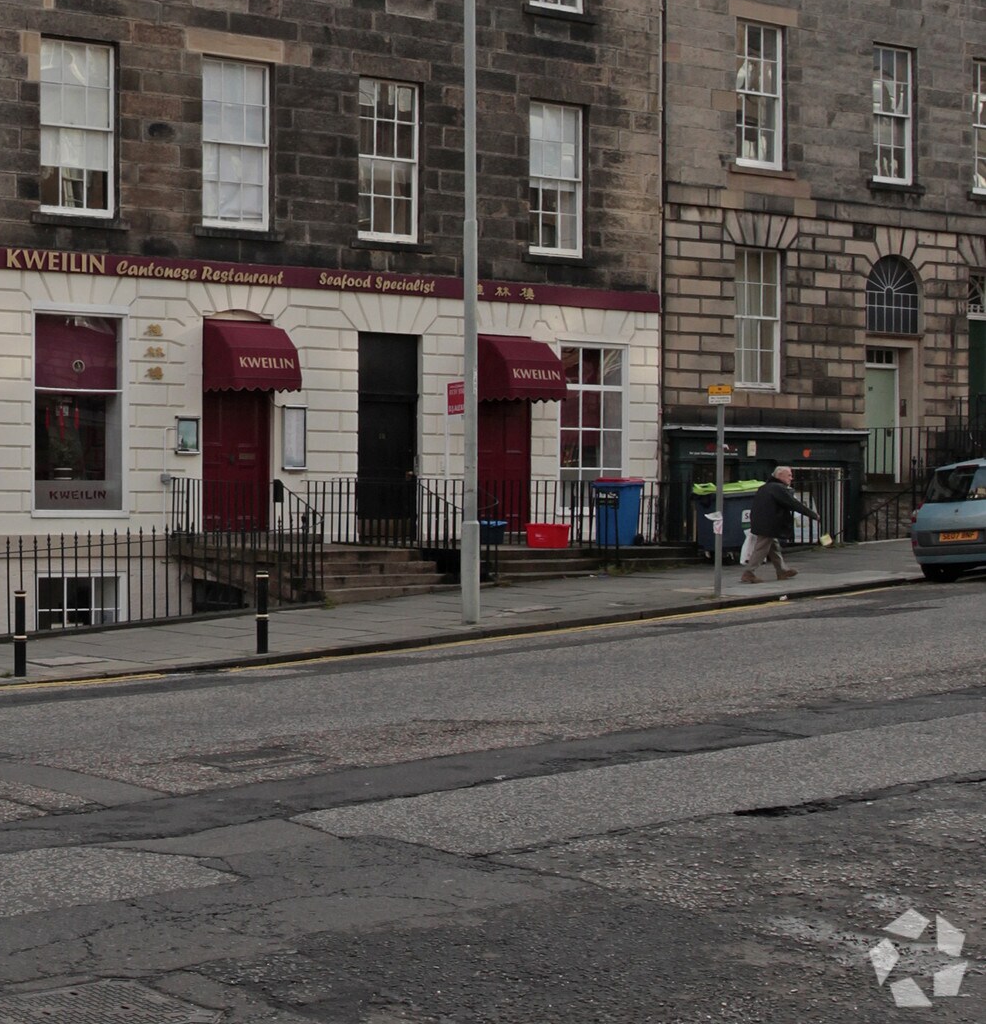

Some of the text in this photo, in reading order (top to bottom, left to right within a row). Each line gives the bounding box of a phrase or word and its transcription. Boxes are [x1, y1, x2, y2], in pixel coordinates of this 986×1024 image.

[6, 248, 436, 293] KWEILIN Cantonese Restaurant Seafood Specialist
[239, 356, 295, 370] KWEILIN
[512, 368, 561, 381] KWEILIN
[49, 489, 107, 501] KWEILIN
